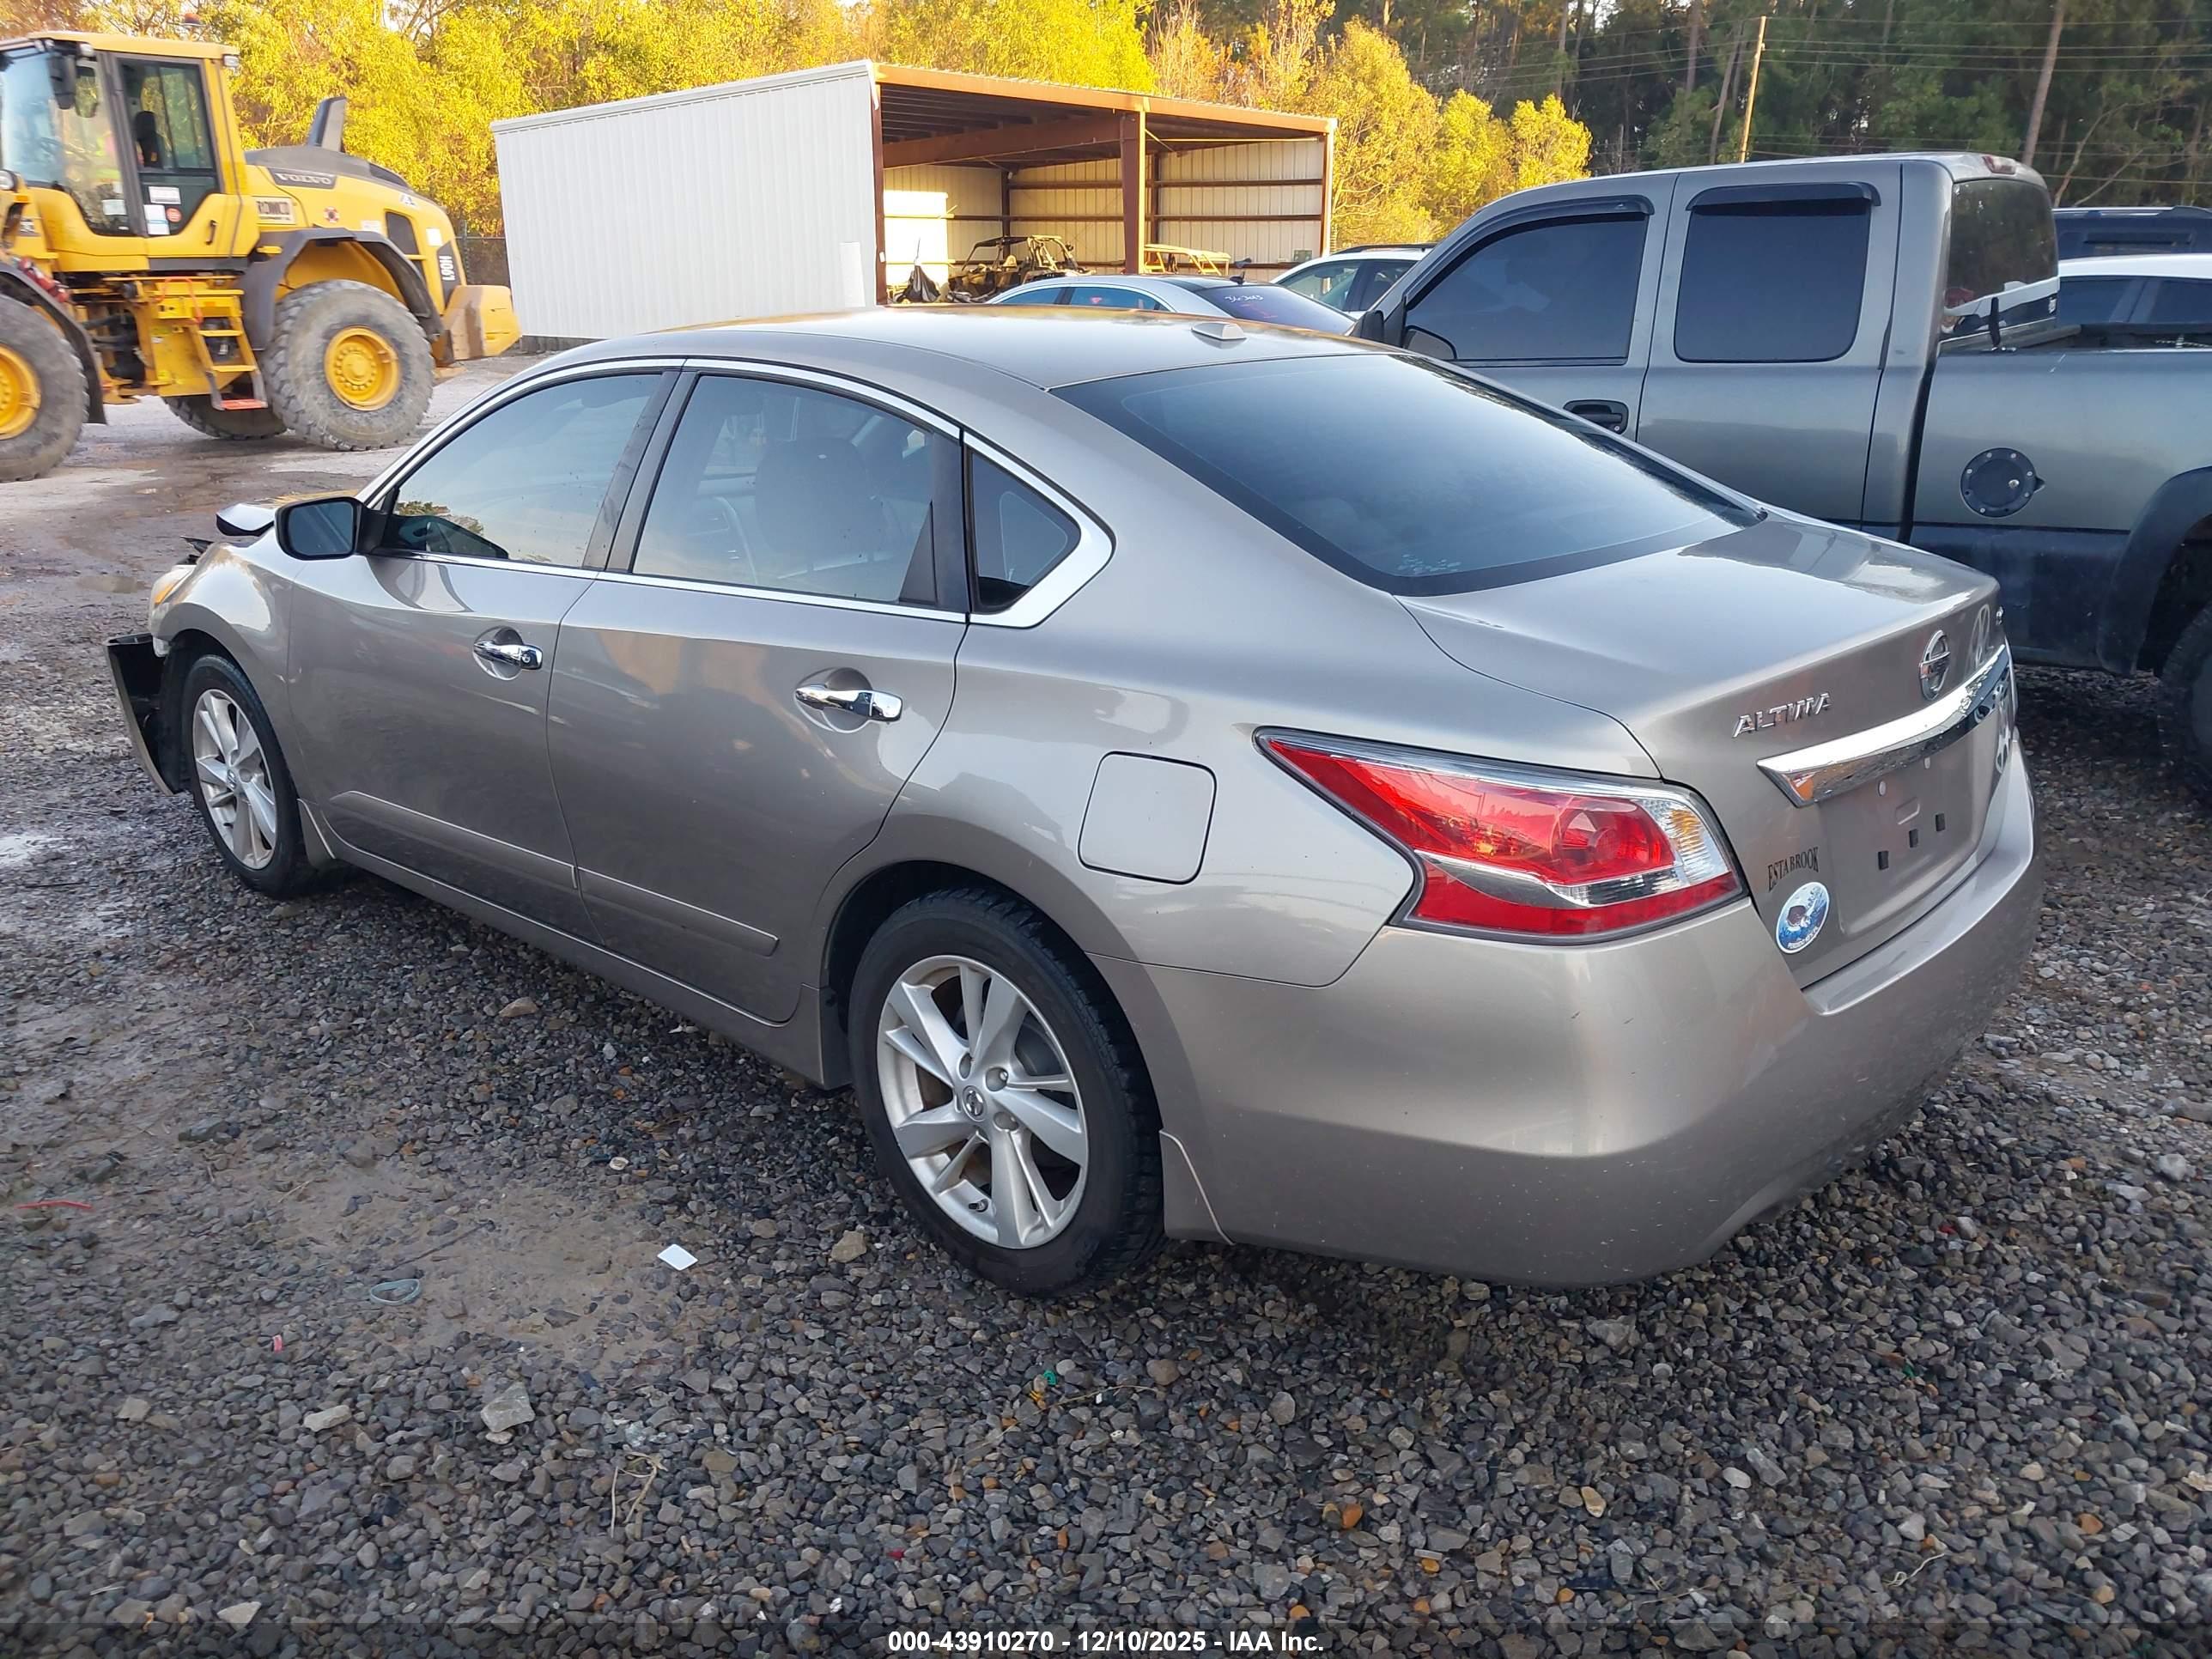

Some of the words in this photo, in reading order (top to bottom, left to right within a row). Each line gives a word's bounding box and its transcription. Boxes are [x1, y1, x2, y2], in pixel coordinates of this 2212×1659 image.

[275, 172, 331, 185] VOLVO
[1732, 692, 1832, 738] ALTIMA
[1767, 846, 1820, 892] ESTABROOK
